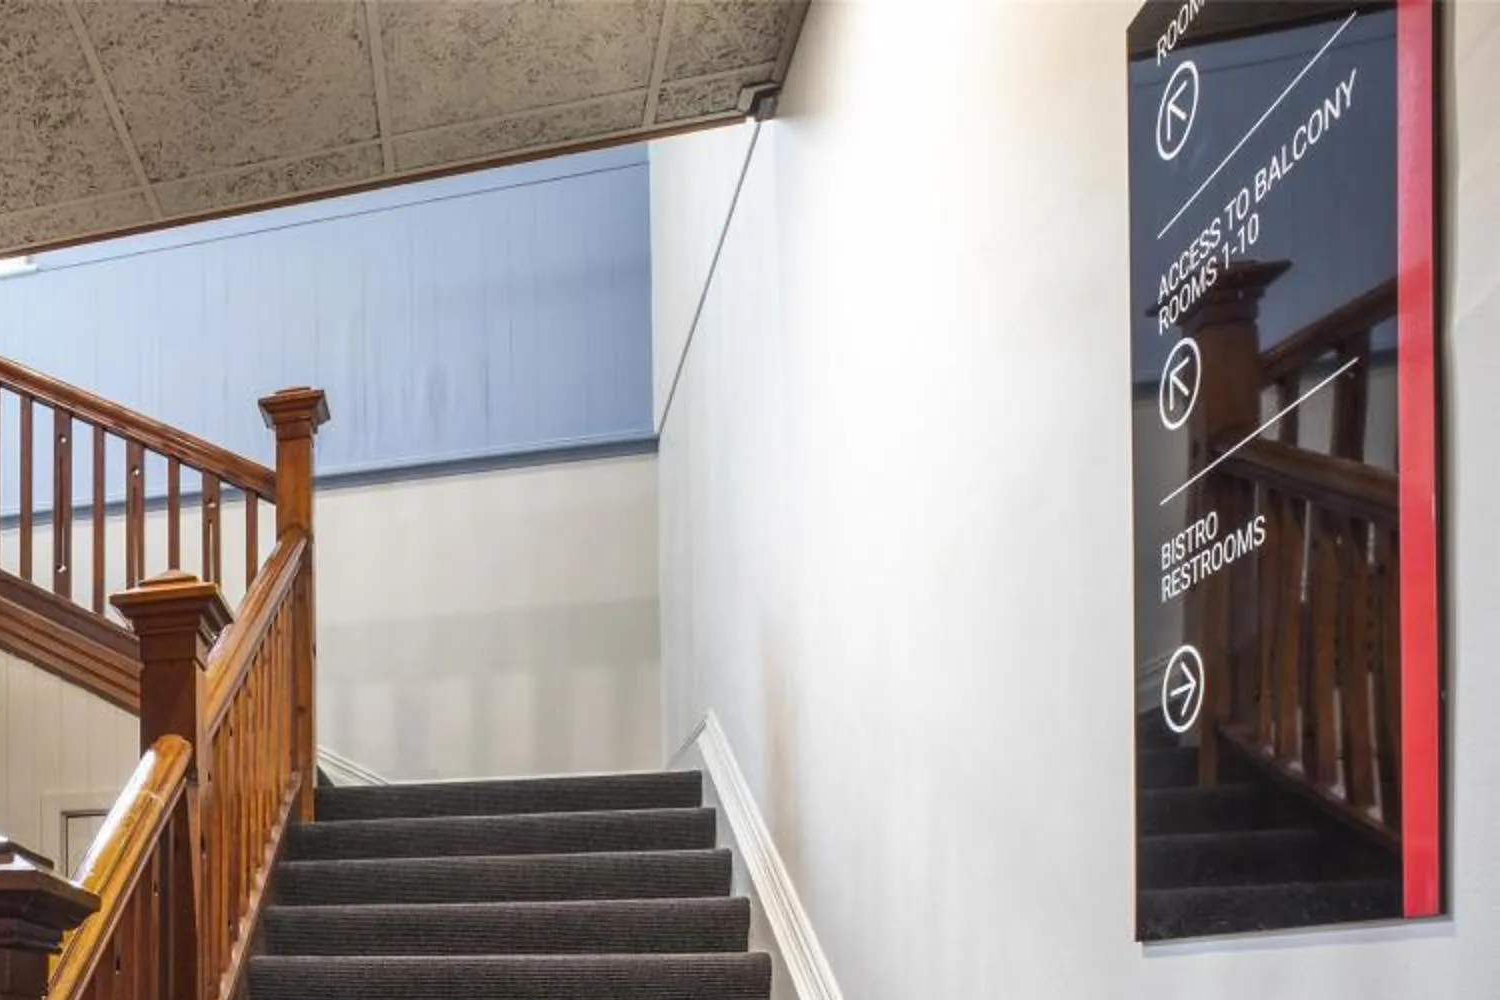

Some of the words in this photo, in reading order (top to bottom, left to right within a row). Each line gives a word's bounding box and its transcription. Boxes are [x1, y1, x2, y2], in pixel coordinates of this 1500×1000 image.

[1158, 217, 1220, 304] ACCESS
[1225, 187, 1249, 230] TO
[1254, 68, 1357, 202] BALCONY
[1158, 255, 1218, 335] ROOMS
[1221, 213, 1259, 270] 1-10
[1161, 510, 1218, 571] BISTRO
[1161, 515, 1266, 602] RESTROOMS
